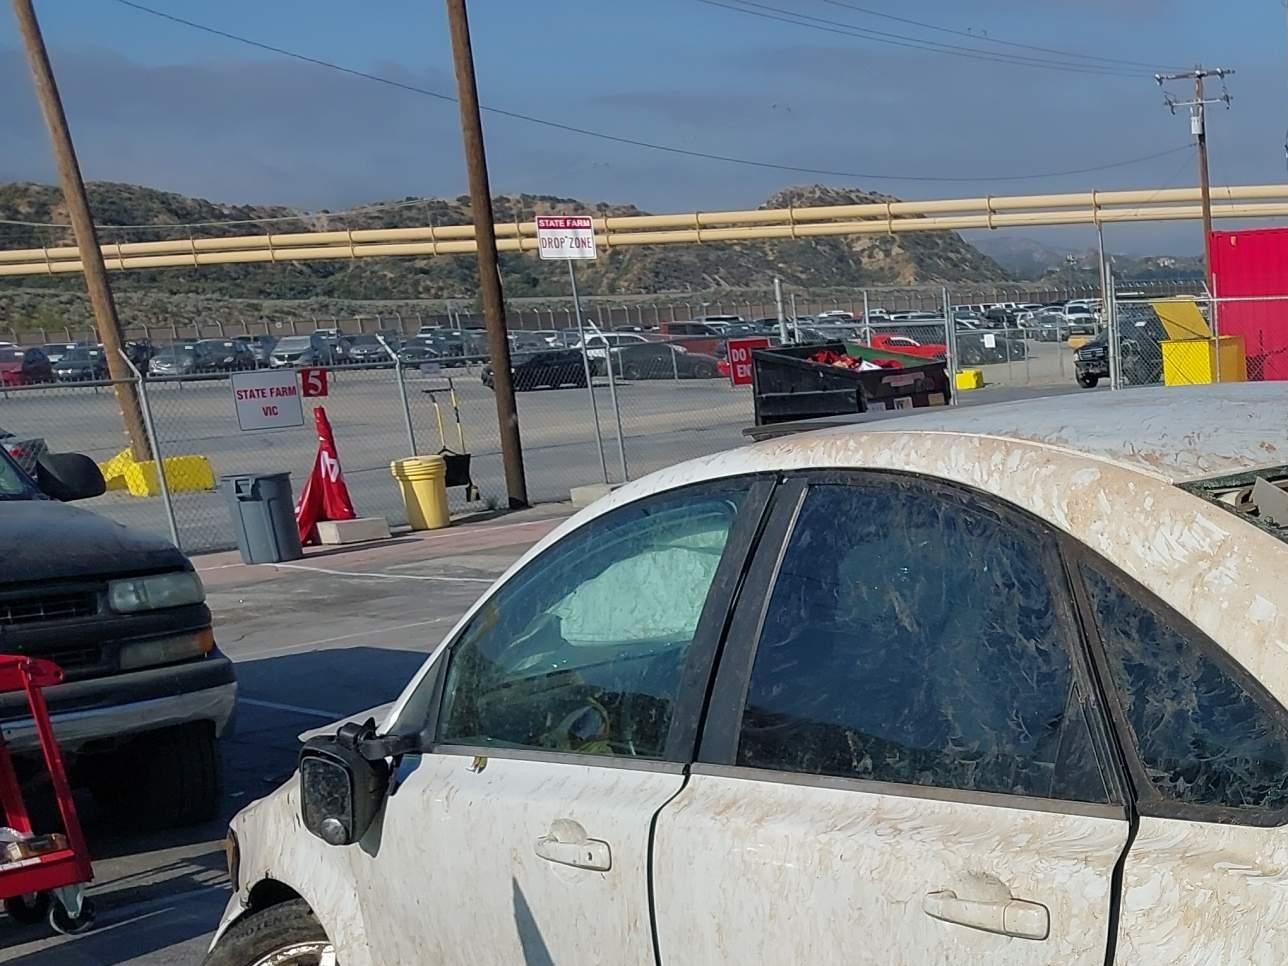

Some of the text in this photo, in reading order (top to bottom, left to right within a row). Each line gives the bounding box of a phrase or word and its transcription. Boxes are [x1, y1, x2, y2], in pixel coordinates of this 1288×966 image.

[539, 218, 590, 227] STATE FARM
[541, 236, 593, 249] DROP ZONE
[731, 348, 747, 362] DO
[308, 370, 322, 395] 5
[236, 385, 297, 401] STATE FARM
[262, 406, 279, 417] VIC
